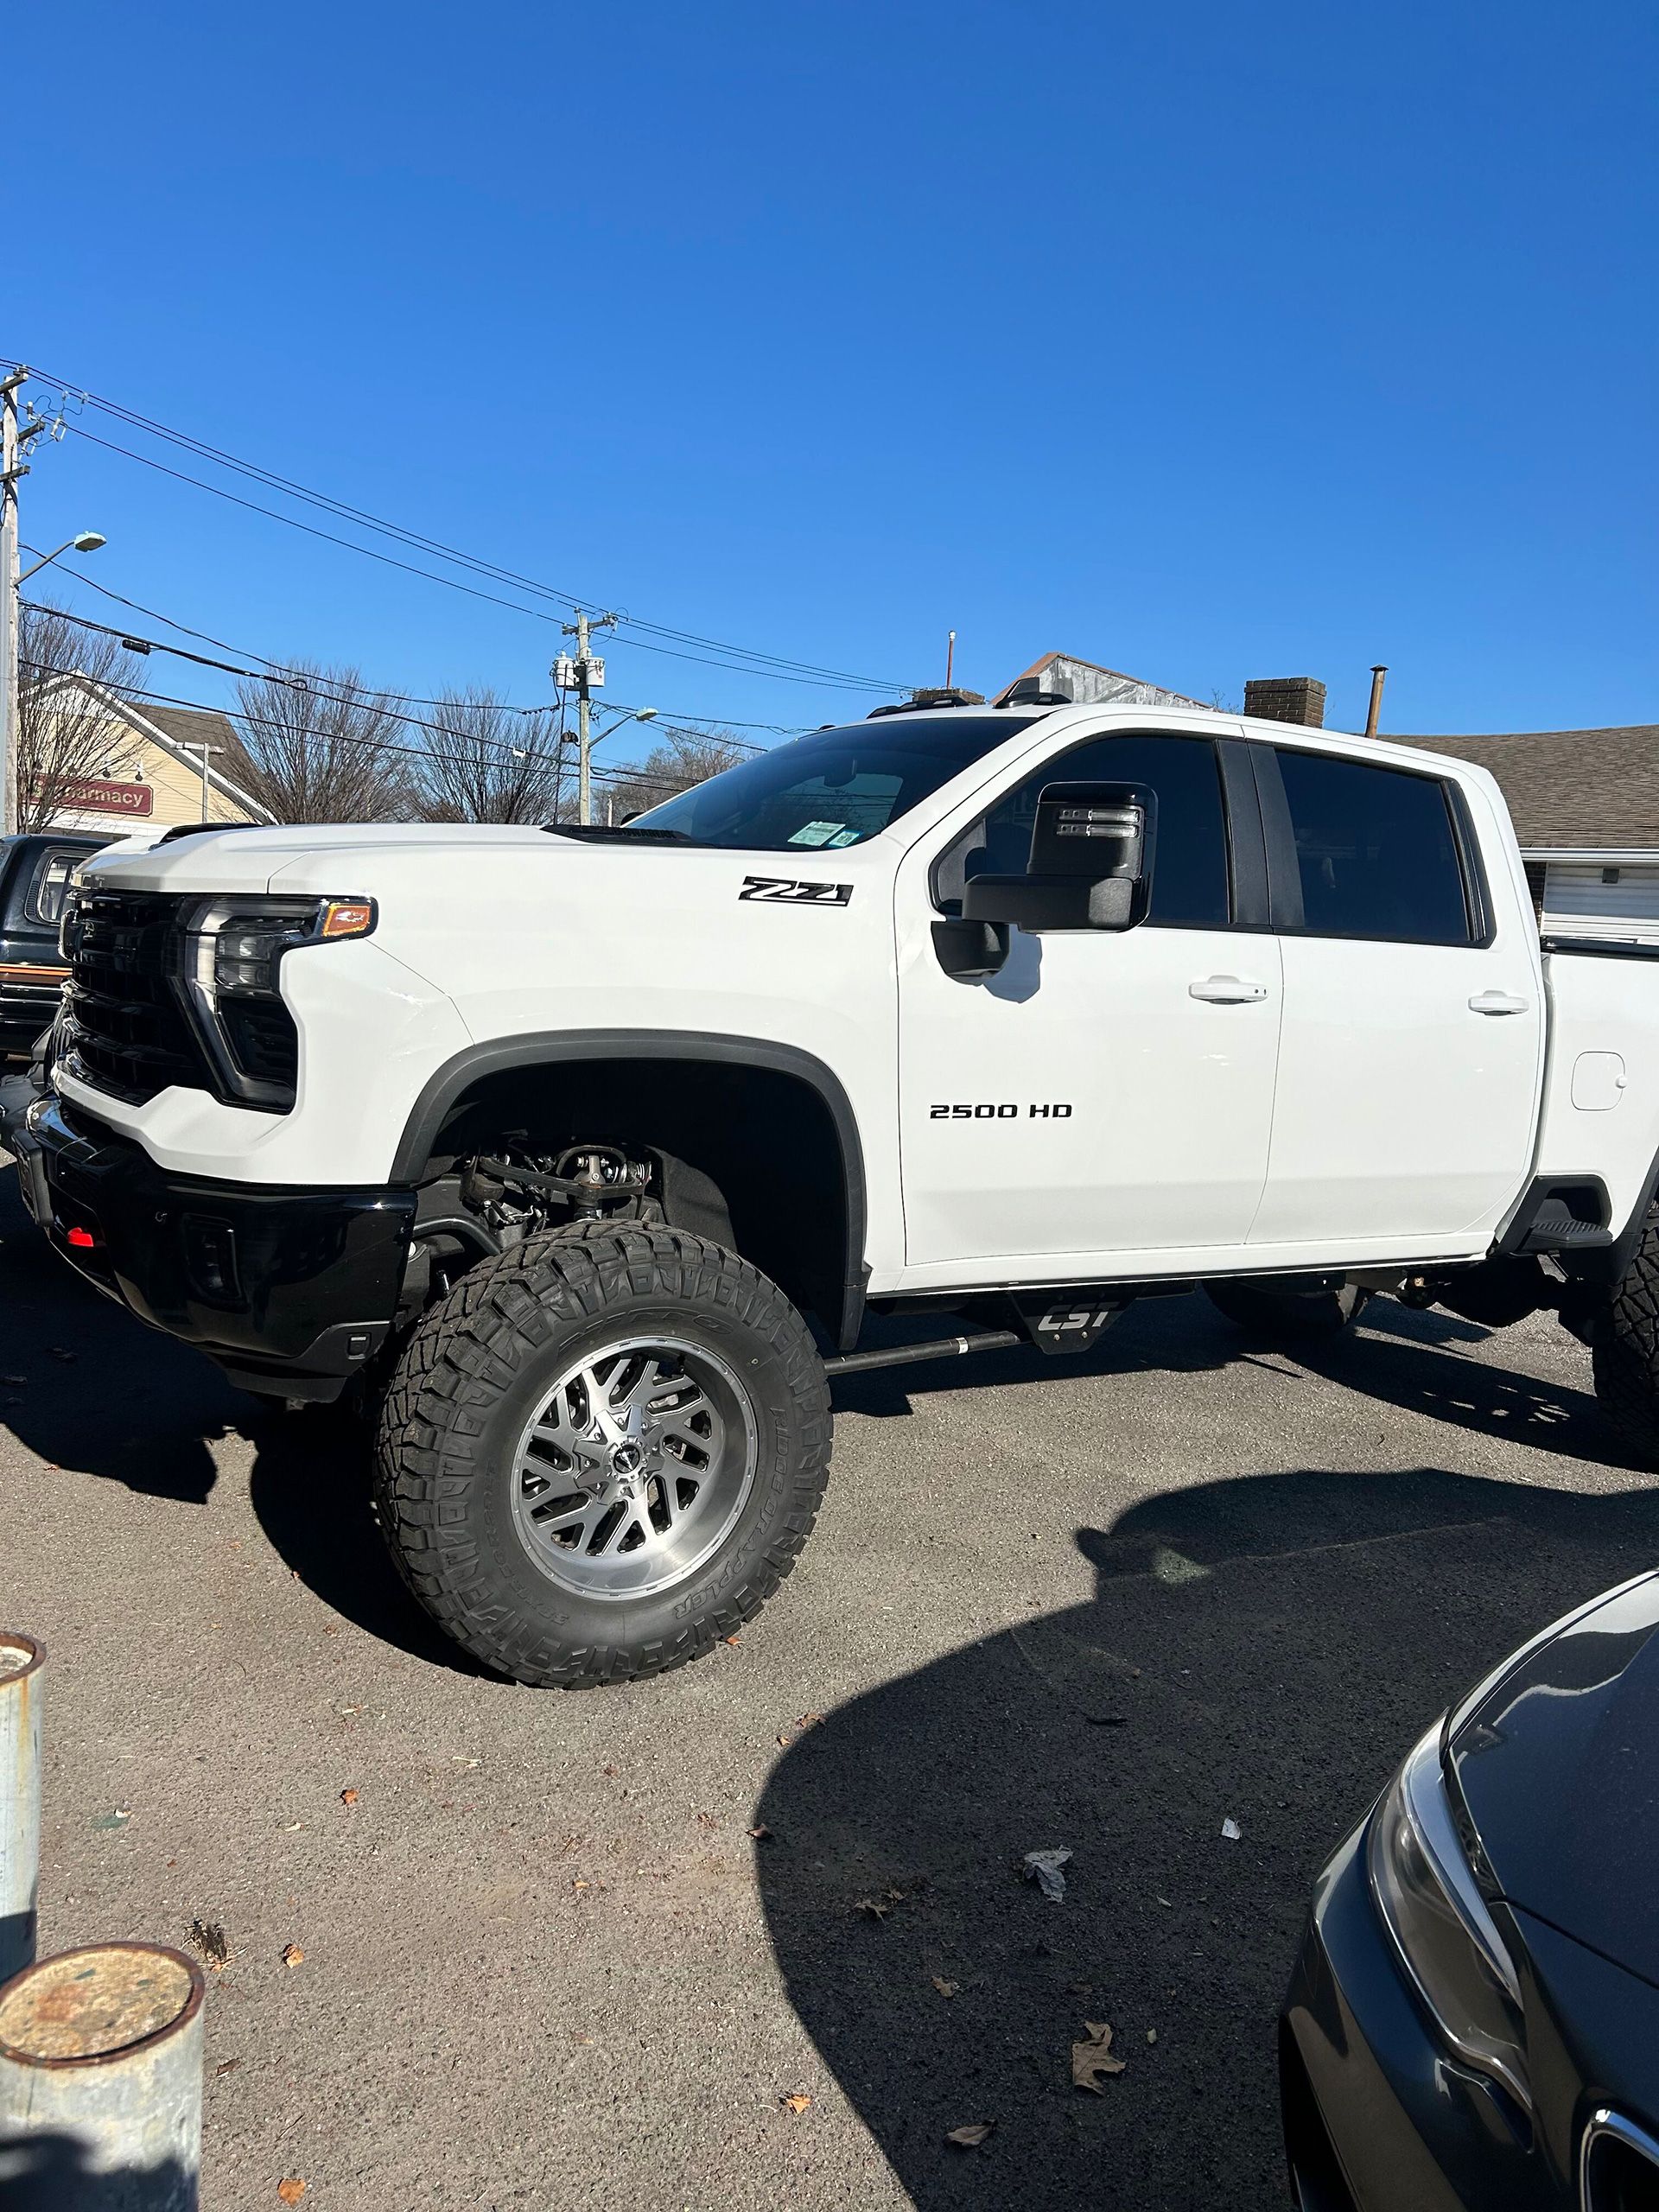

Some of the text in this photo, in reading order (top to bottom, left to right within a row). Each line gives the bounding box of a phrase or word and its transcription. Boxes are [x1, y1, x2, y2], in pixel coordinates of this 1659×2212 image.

[930, 1104, 1072, 1119] 2500 HD
[673, 1407, 791, 1620] RIDGE GRAPPLER
